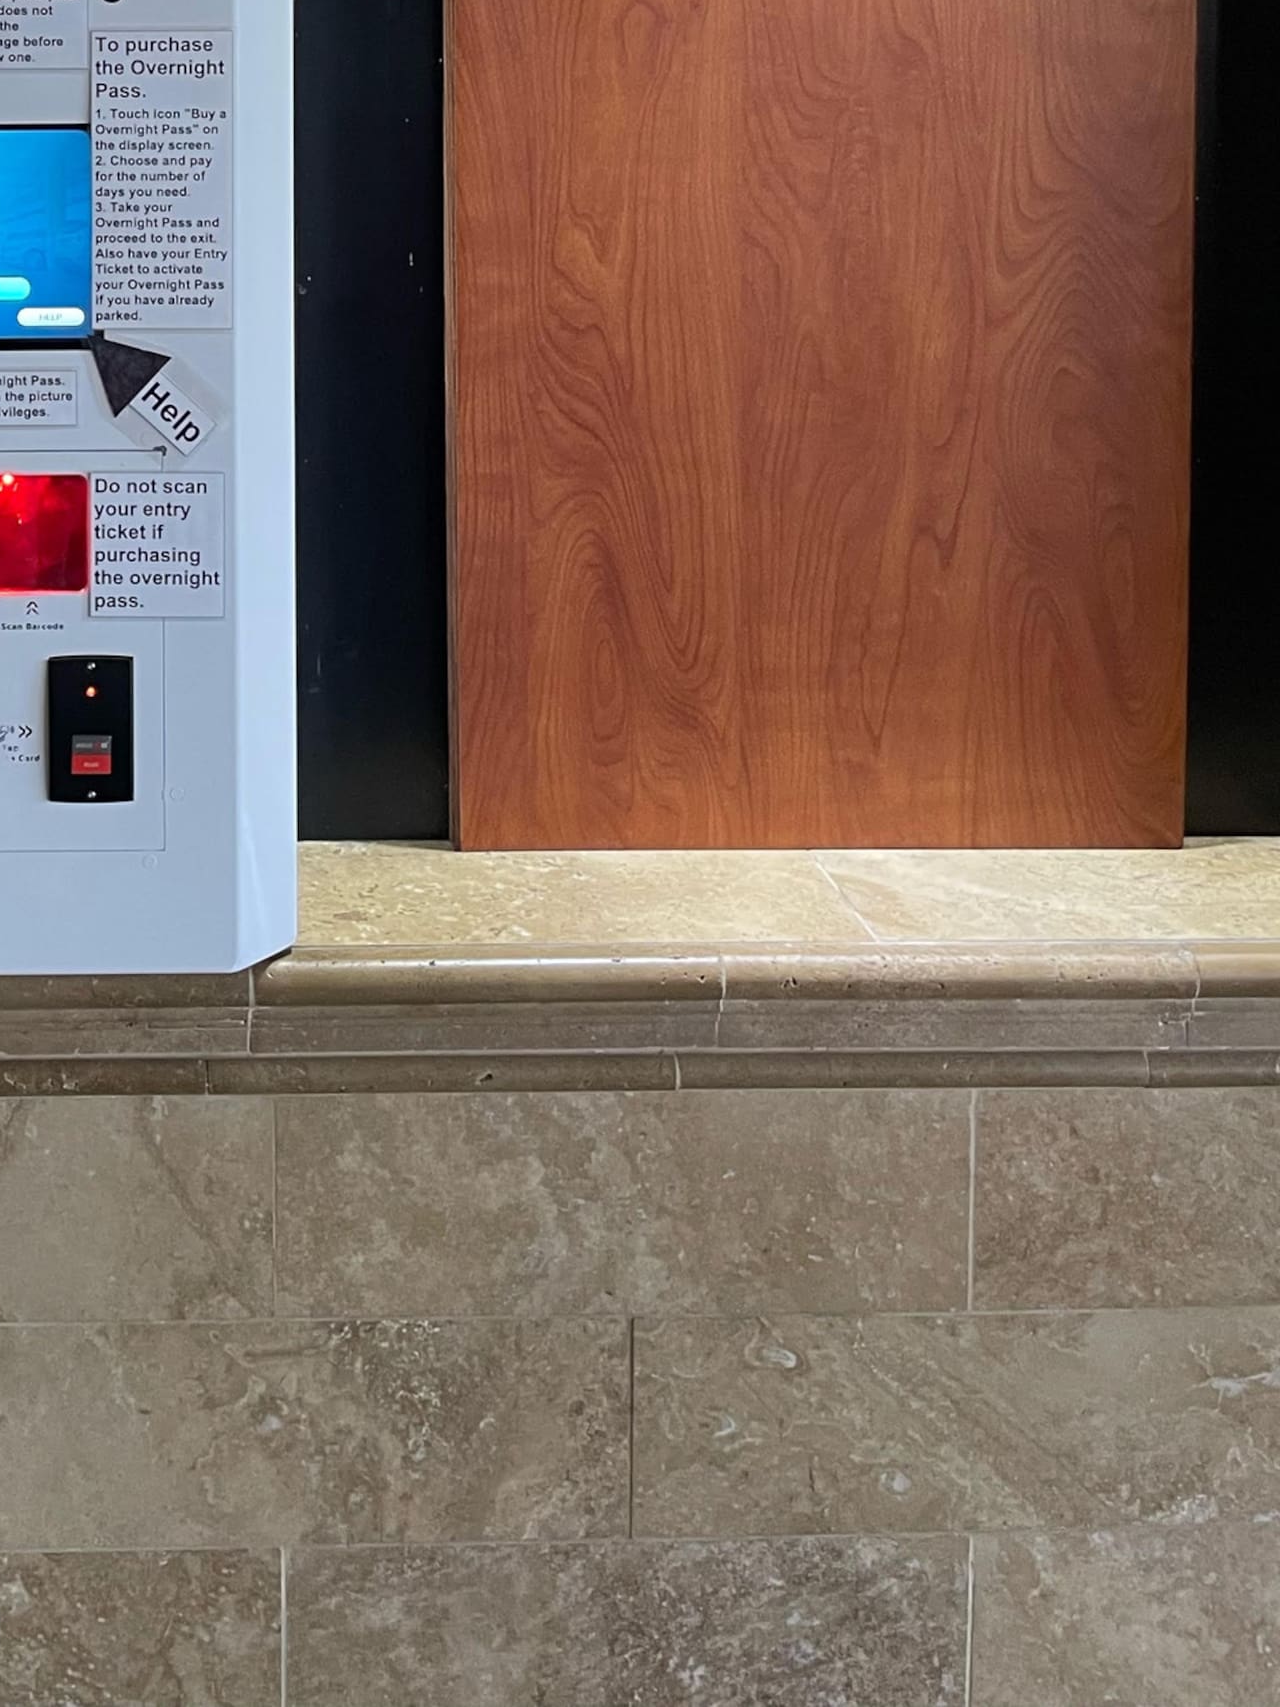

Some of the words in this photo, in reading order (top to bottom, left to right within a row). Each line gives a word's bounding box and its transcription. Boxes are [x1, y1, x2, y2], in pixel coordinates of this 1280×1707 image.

[95, 36, 119, 53] To
[125, 36, 214, 55] purchase
[95, 59, 125, 76] the
[130, 59, 225, 79] Overnight
[95, 82, 147, 99] Pass.
[141, 382, 200, 442] Help
[95, 477, 121, 494] Do
[127, 479, 157, 494] not
[162, 481, 207, 495] scan
[93, 504, 138, 521] your
[142, 501, 191, 521] entry
[93, 523, 147, 540] ticket
[152, 524, 165, 540] if
[94, 546, 201, 567] purchasing
[93, 569, 124, 585] the
[129, 569, 221, 590] overnight
[94, 595, 145, 612] pass.
[1, 622, 23, 631] Scan
[25, 622, 65, 631] Barcode
